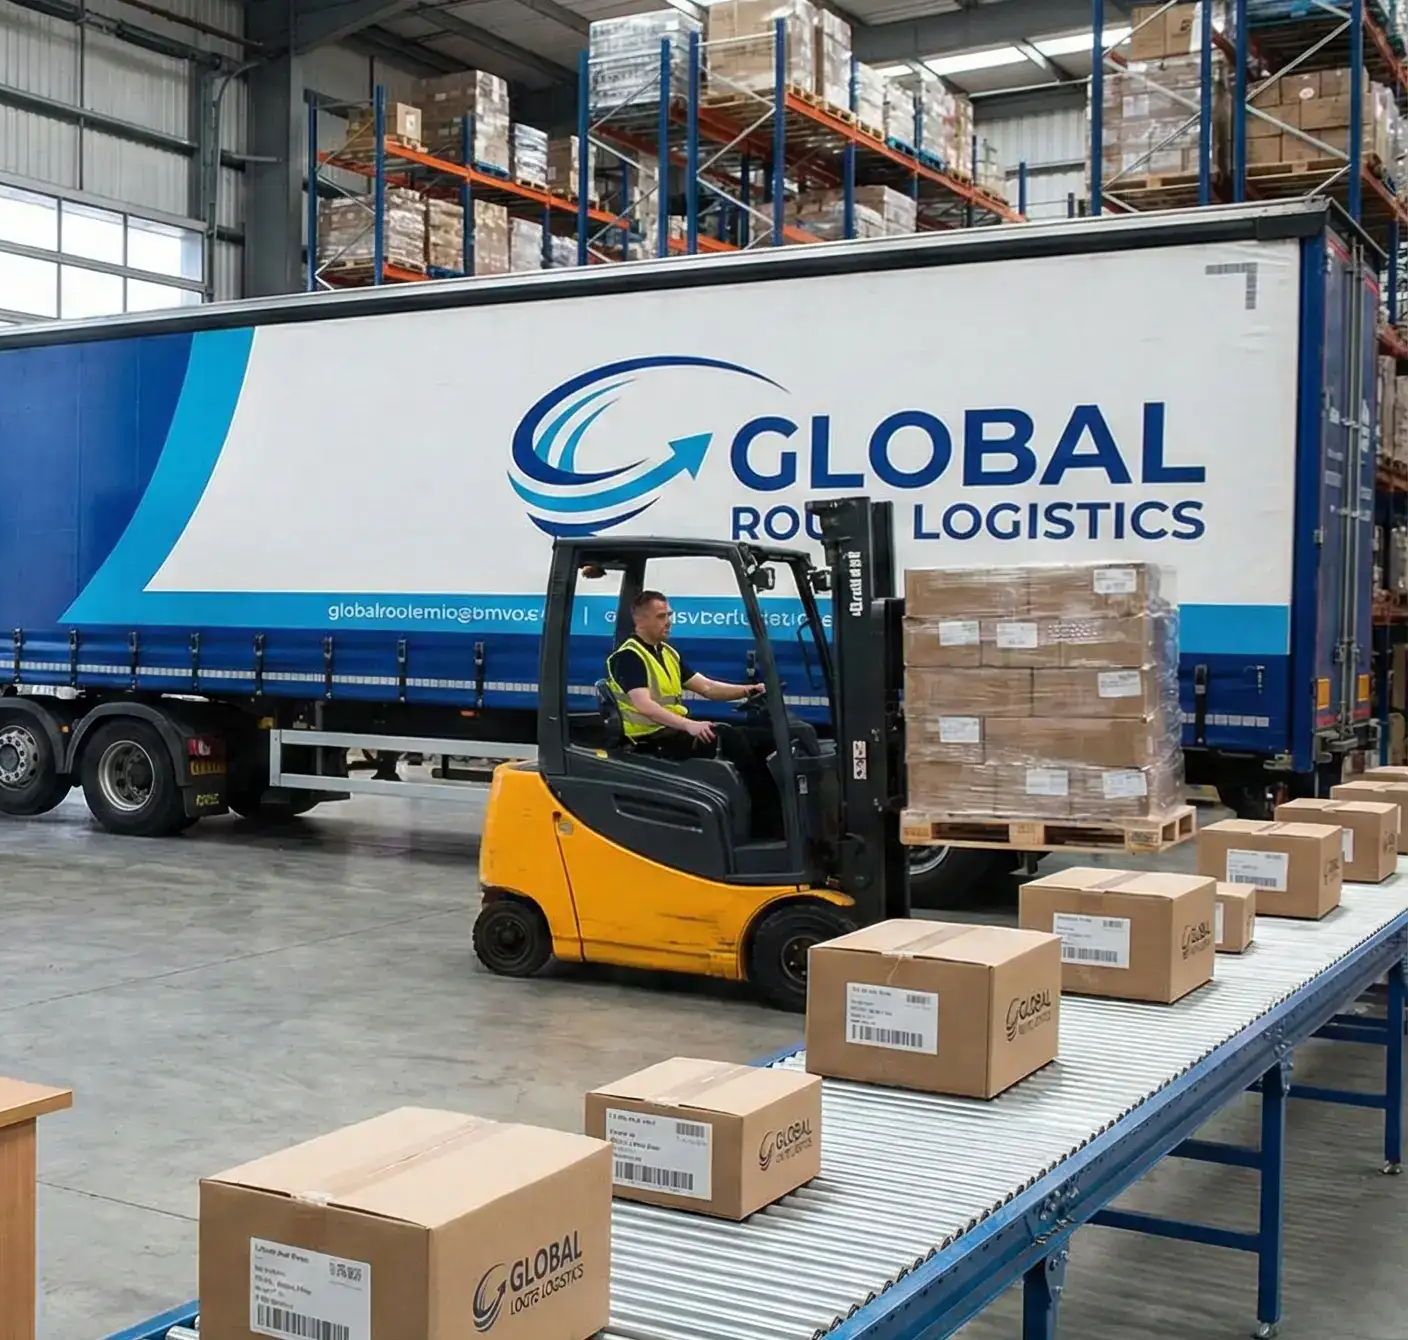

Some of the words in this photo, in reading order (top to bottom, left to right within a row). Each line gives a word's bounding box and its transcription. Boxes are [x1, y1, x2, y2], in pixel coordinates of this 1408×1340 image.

[730, 402, 1206, 492] GLOBAL
[913, 500, 1206, 541] LOGISTICS
[510, 1230, 583, 1292] GLOBAL
